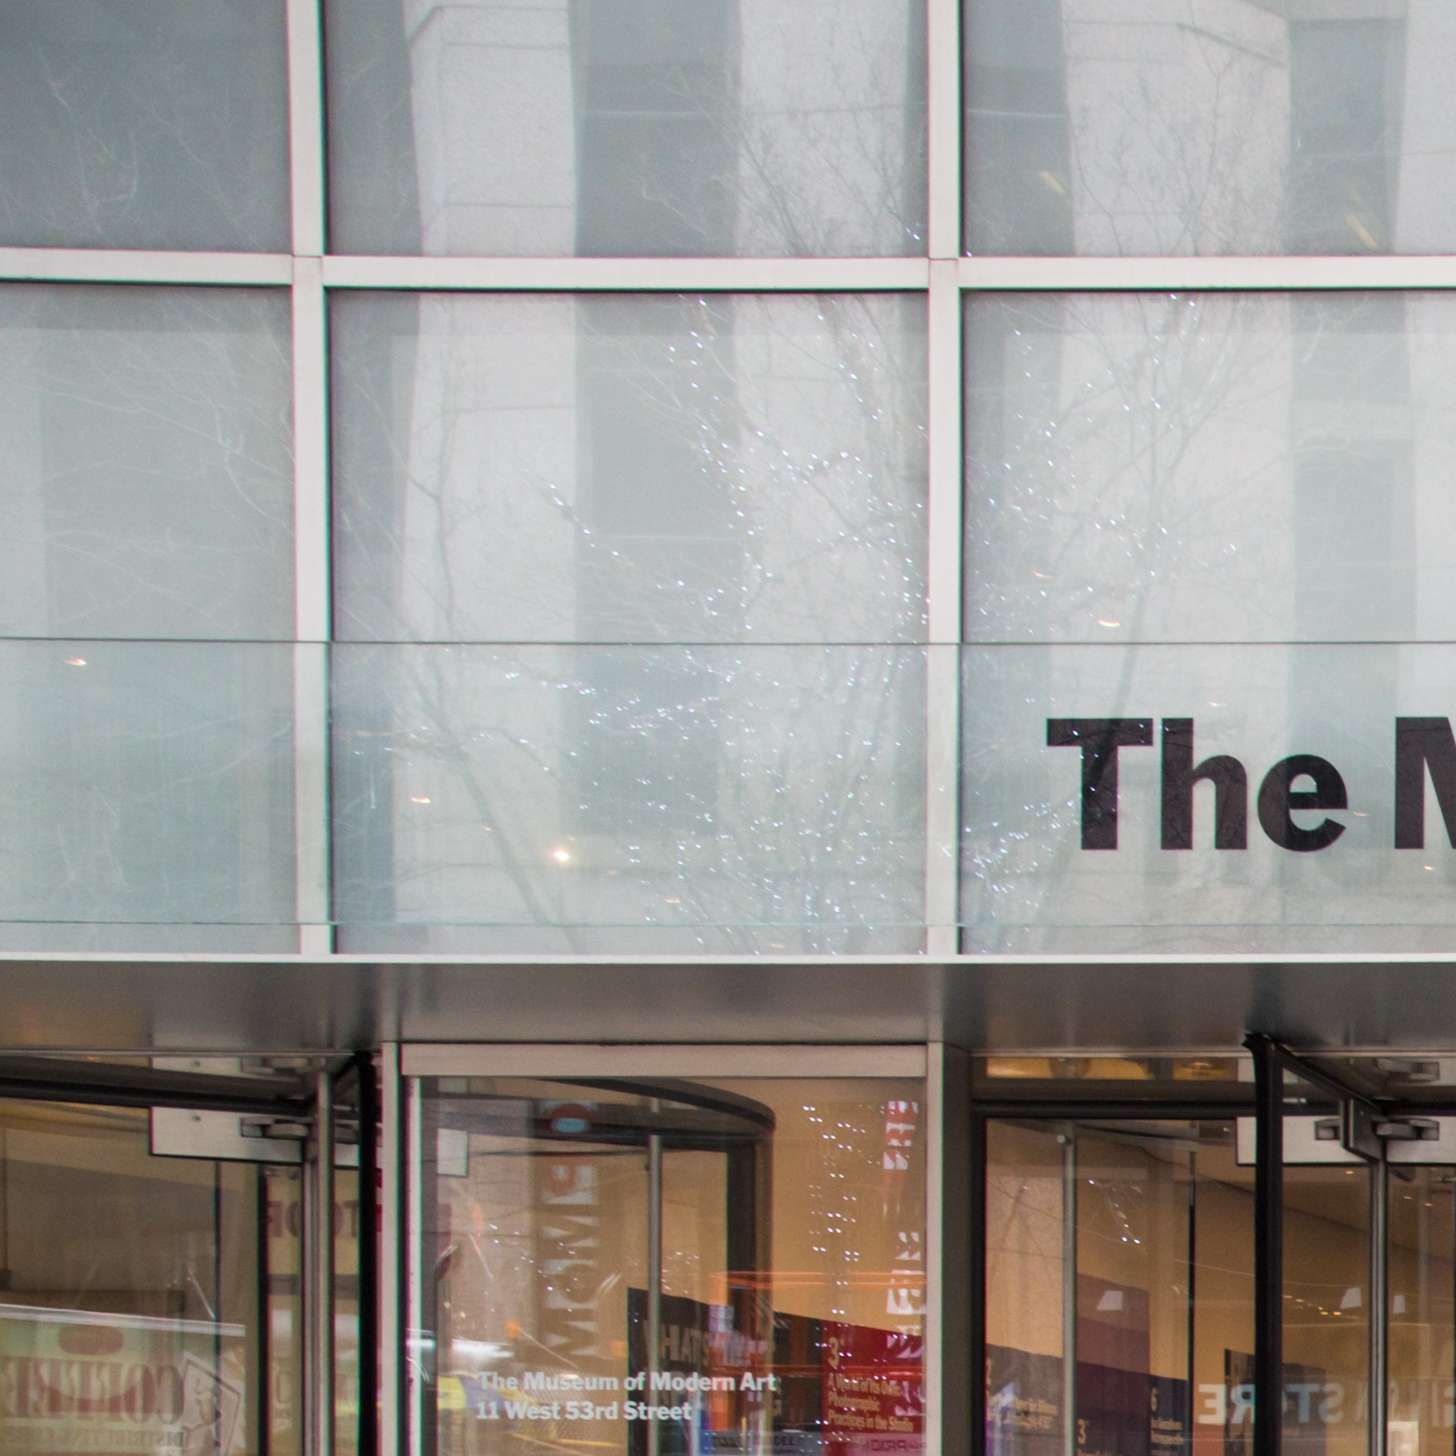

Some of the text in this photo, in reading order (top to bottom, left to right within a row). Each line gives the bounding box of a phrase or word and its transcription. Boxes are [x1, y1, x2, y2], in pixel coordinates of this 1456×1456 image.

[1047, 716, 1349, 853] The
[477, 1372, 778, 1392] The Museum of Modern Art
[477, 1401, 694, 1421] 11 West 53rd Street
